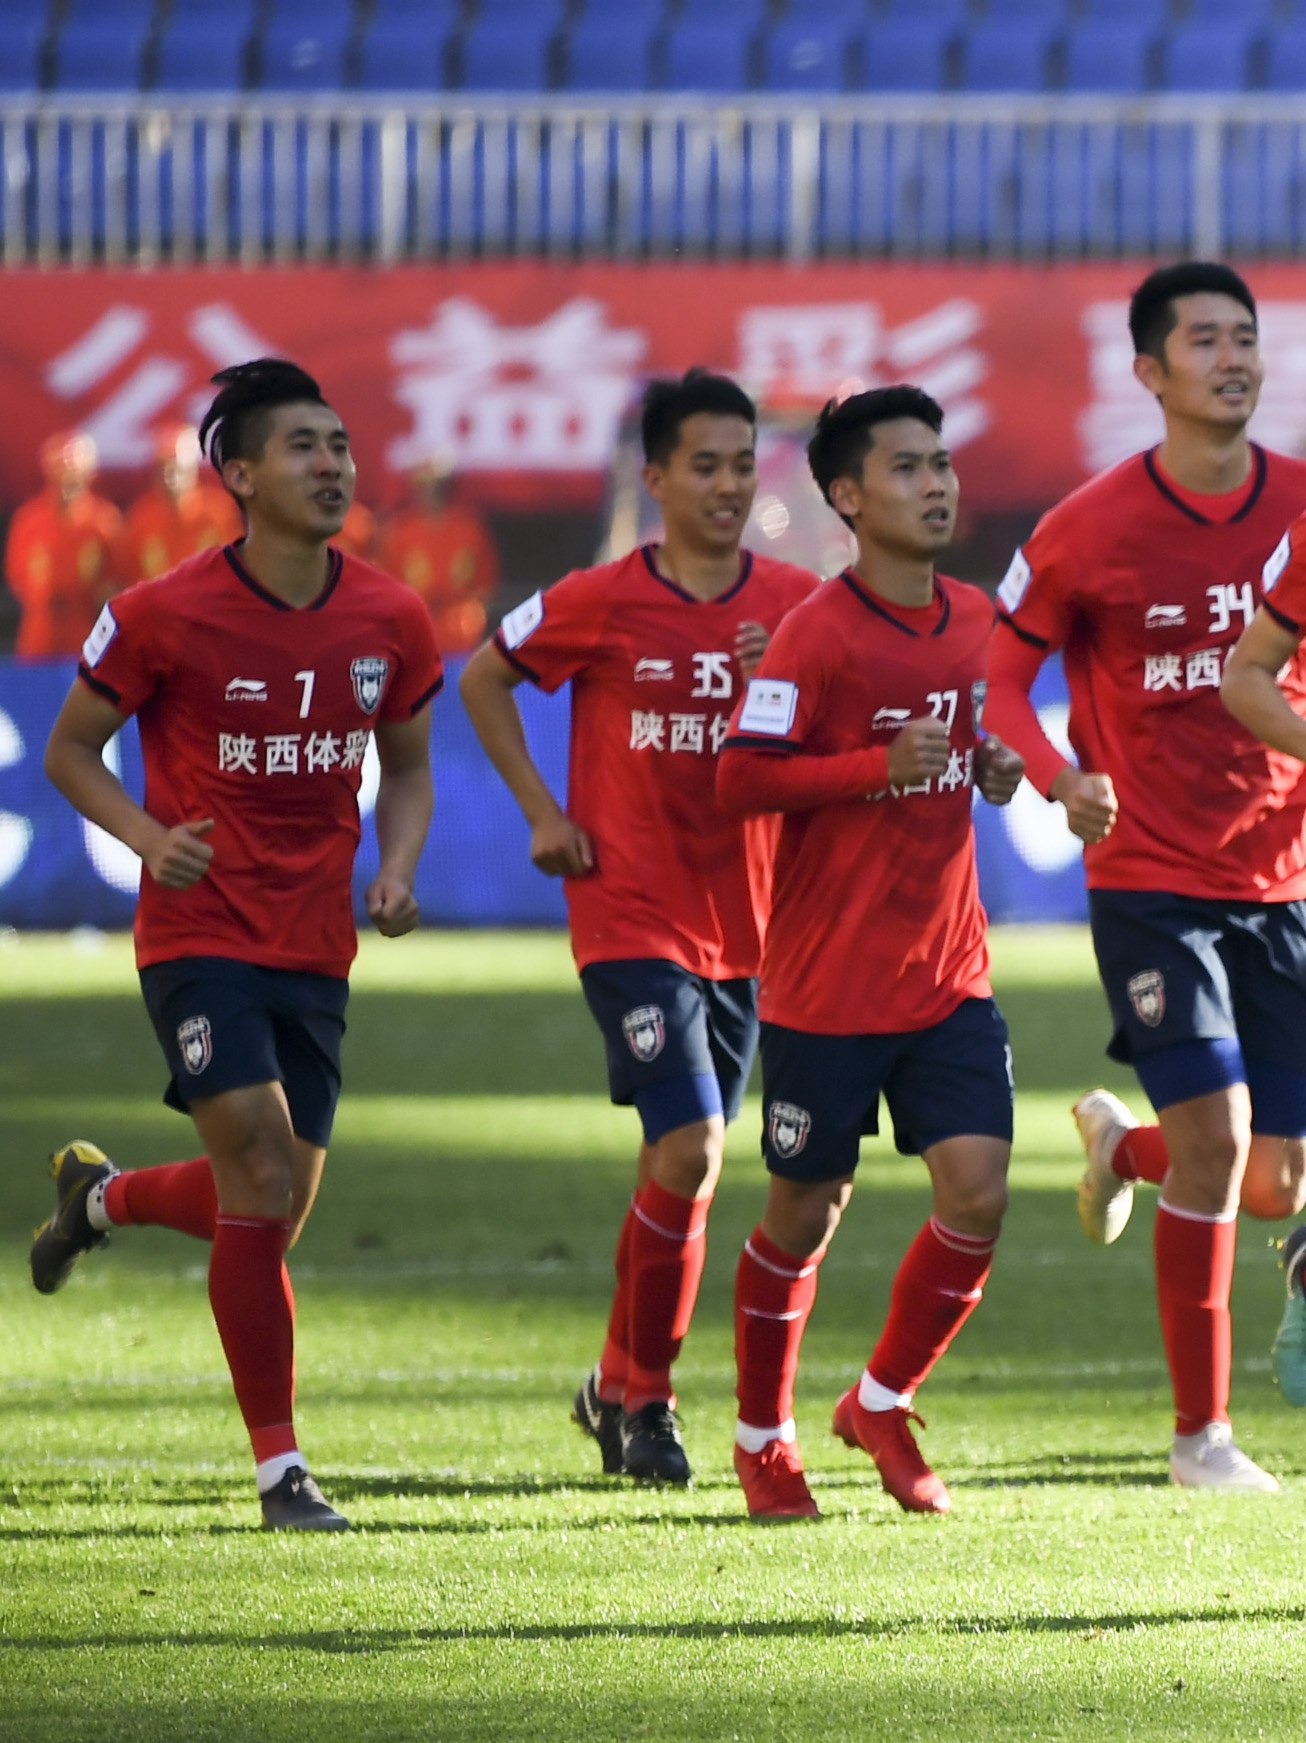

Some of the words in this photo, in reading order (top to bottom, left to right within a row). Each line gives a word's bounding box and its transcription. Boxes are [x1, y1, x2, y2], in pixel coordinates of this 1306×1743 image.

[1206, 581, 1255, 633] 34
[294, 670, 315, 719] 7
[691, 652, 733, 699] 35
